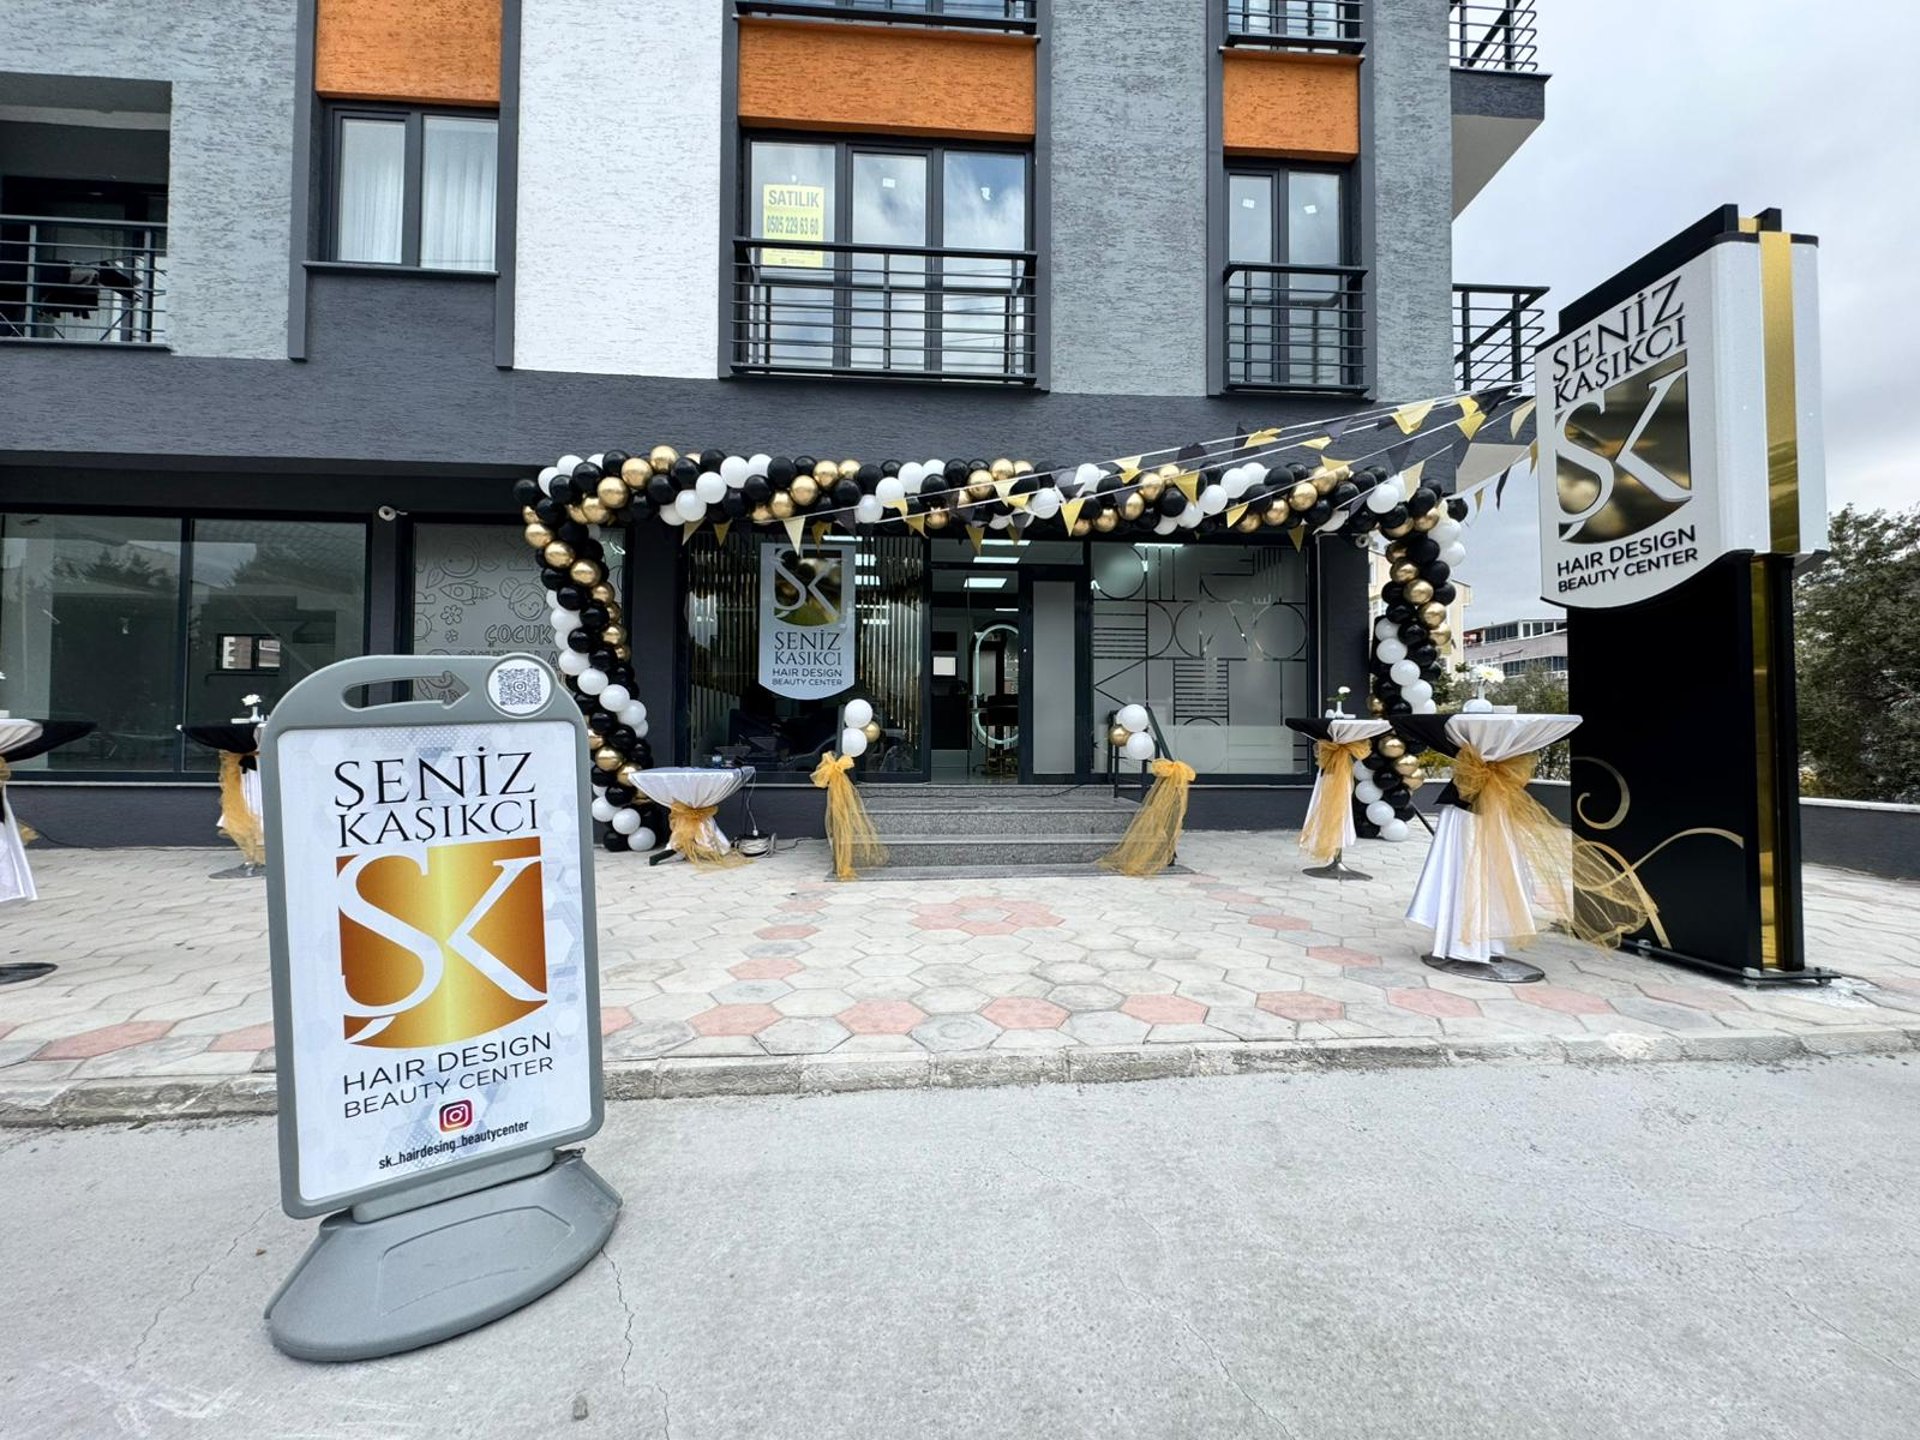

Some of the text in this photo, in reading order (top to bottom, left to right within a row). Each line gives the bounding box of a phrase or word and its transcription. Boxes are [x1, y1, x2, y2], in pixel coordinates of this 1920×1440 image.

[768, 190, 819, 208] SATILIK
[1557, 524, 1696, 577] HAIR DESIGN
[1558, 547, 1698, 593] BEAUTY CENTER
[485, 623, 552, 648] ÇOCUK
[772, 668, 842, 678] HAIR DESIGN
[772, 678, 843, 687] BEAUTY CENTER
[334, 746, 536, 811] ŞENİZ
[337, 799, 538, 848] KAŞIKÇI
[344, 1032, 551, 1095] HAIR DESIGN
[344, 1056, 553, 1118] BEAUTY CENTER
[378, 1120, 529, 1169] sk_hairdesing_beautycenter
